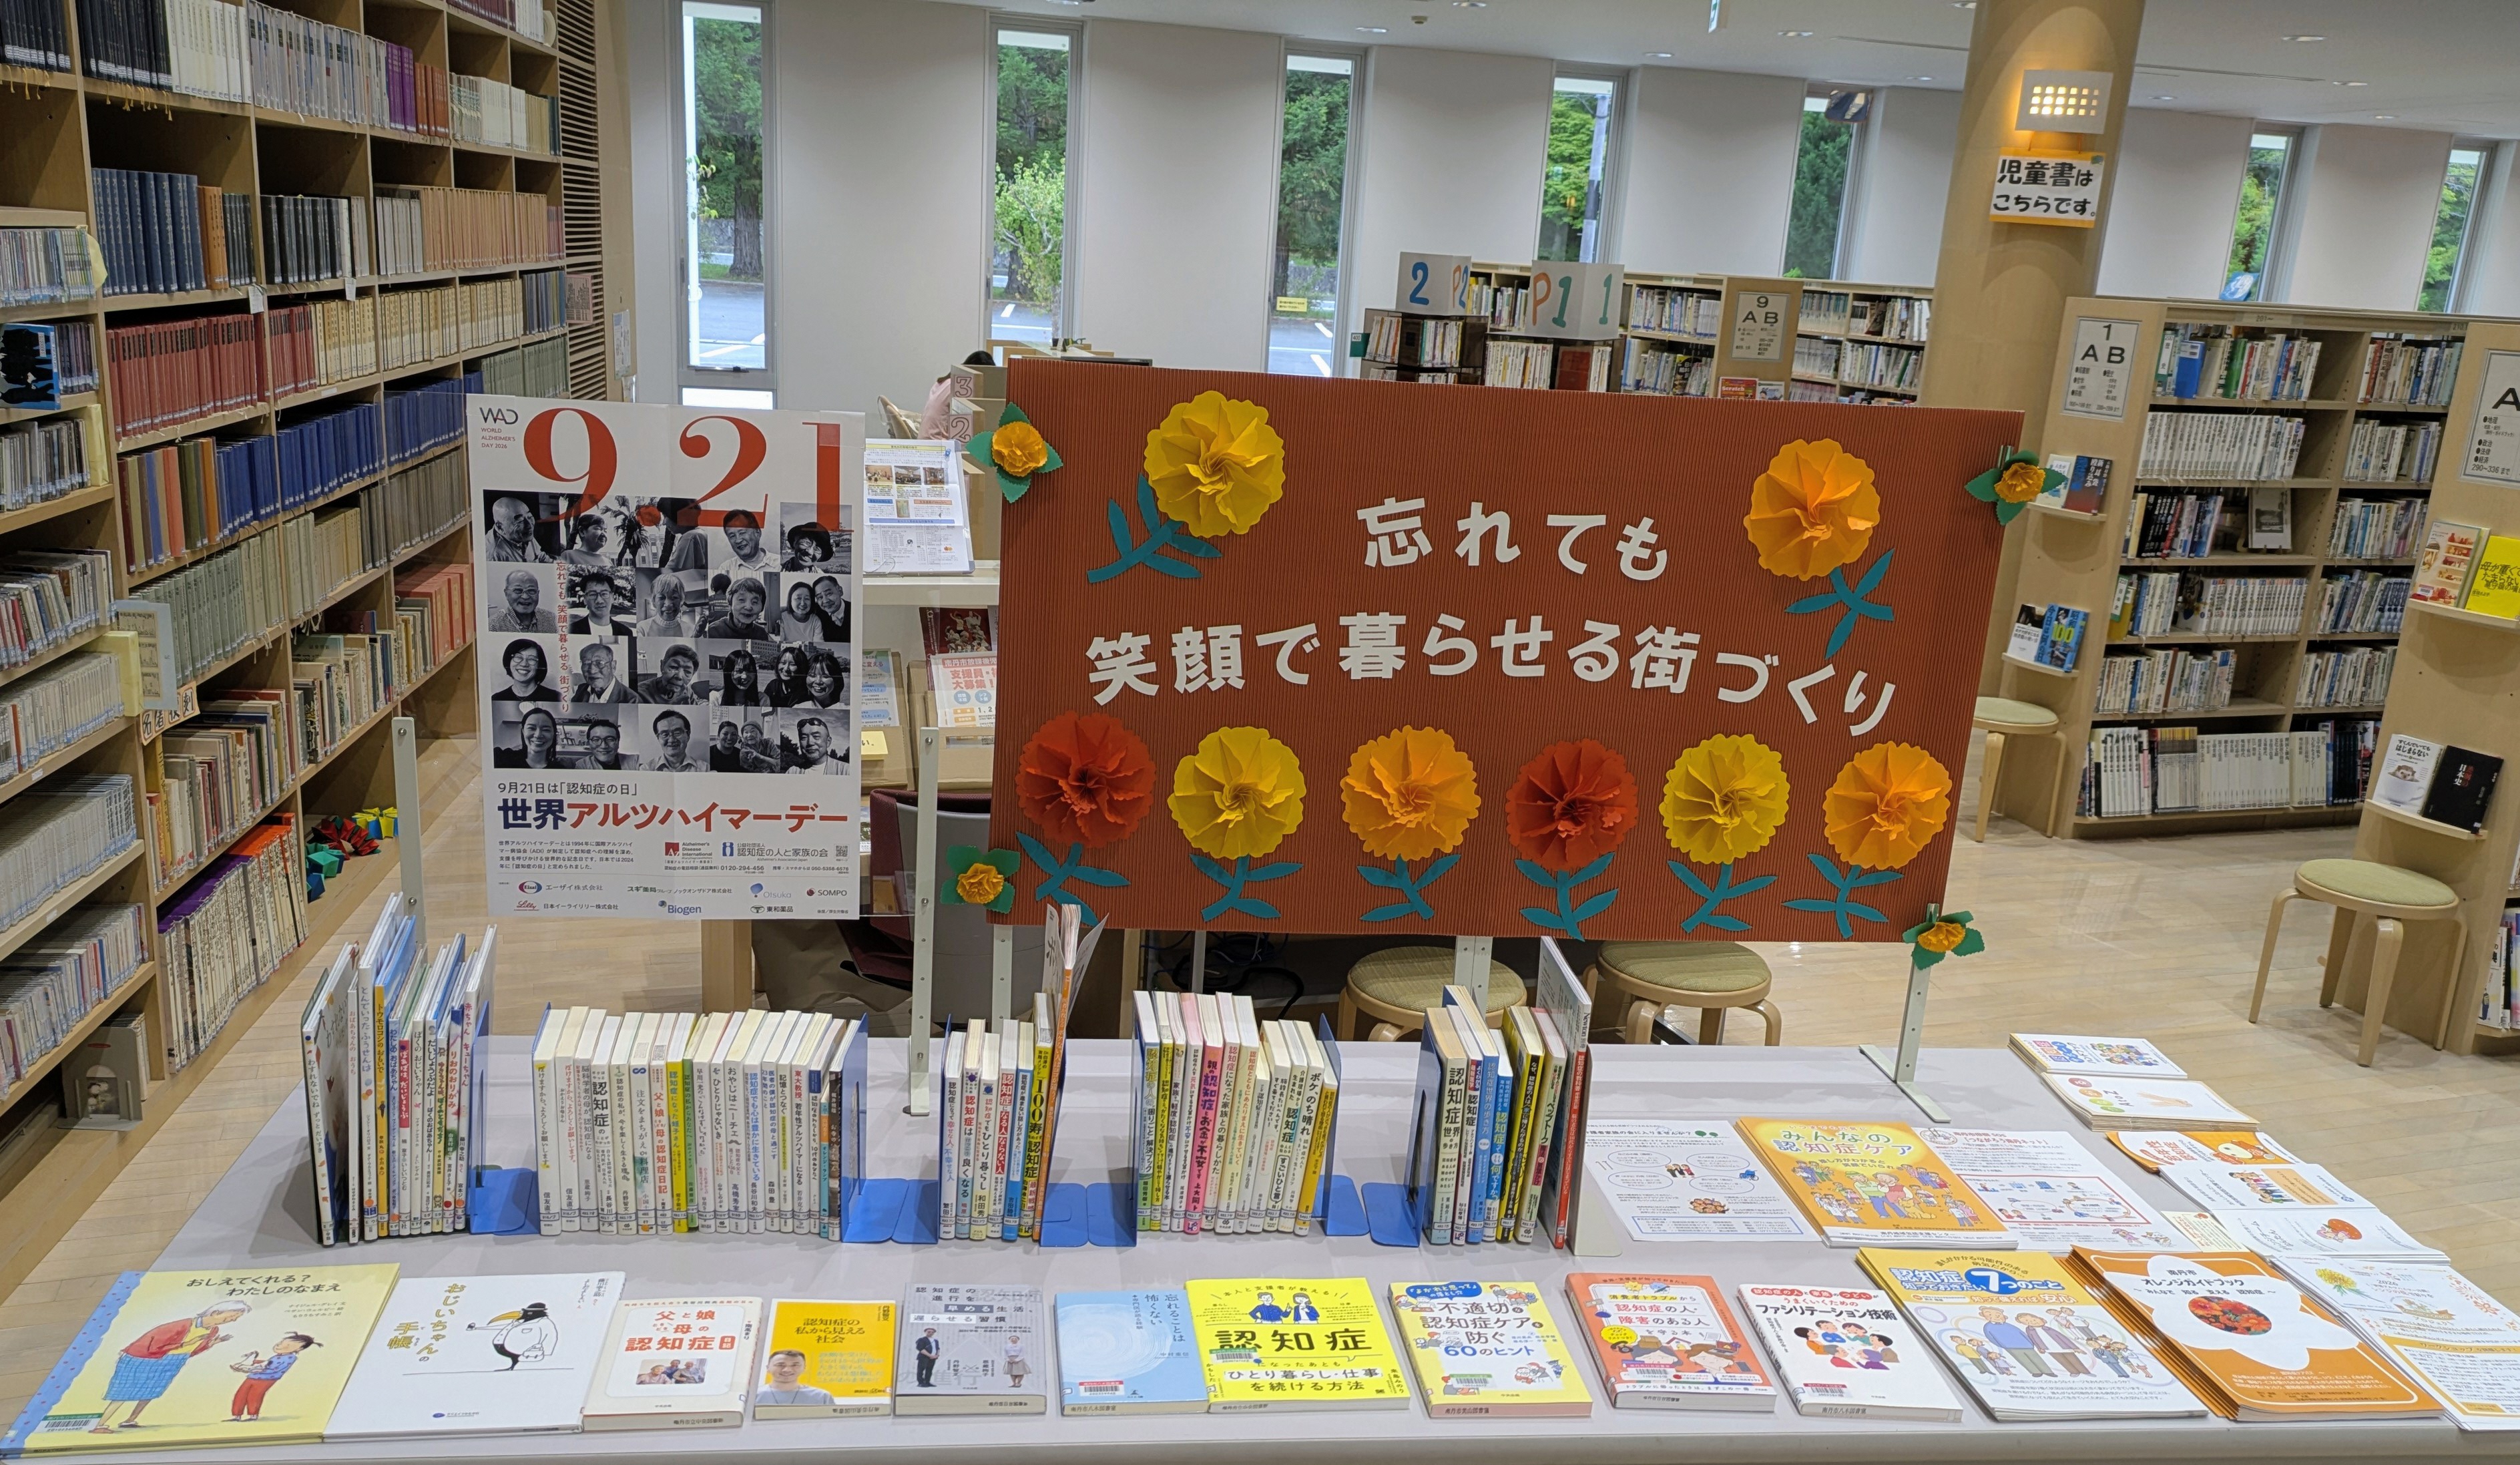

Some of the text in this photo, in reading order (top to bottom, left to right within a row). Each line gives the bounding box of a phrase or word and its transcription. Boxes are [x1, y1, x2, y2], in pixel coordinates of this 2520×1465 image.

[1997, 159, 2093, 187] 児童書は
[1993, 194, 2095, 217] こちらです。
[1409, 262, 1430, 306] 2
[1453, 264, 1469, 309] P2
[1532, 272, 1572, 329] P1
[1599, 273, 1613, 325] 1
[1756, 296, 1769, 308] 9
[1742, 310, 1778, 324] A B
[2102, 323, 2112, 341] 1
[2080, 344, 2125, 365] A B
[2491, 387, 2520, 411] A
[951, 417, 971, 443] 2
[523, 407, 854, 533] 9.21
[1356, 497, 1671, 582] 忘れても
[555, 561, 571, 714] 忘れても 笑顔で暮らせる 街づくり
[1085, 611, 1897, 737] 笑顔で暮らせる街づくり
[497, 782, 638, 796] 9月21日は「認知症の日」
[2453, 763, 2467, 787] 日本史
[497, 798, 848, 833] 世界アルツハイマーデー
[737, 847, 828, 857] 認知症の人と家族の会
[668, 904, 702, 915] Biogen
[763, 891, 792, 899] Otsuka
[818, 889, 848, 897] SOMPO
[348, 1010, 356, 1052] おばあちゃんの
[360, 987, 371, 1072] とんでいった ふうせんは
[375, 1004, 385, 1073] トウモロコシの おもいで
[461, 1002, 473, 1086] 赤ちゃん キューちゃん
[389, 1028, 398, 1091] わたしの おばあちゃん
[413, 1031, 423, 1096] ぼくの おじいちゃん
[427, 1039, 437, 1097] だいじょうぶだよ
[447, 1052, 458, 1108] りおのおりがみ
[779, 1074, 787, 1116] 記憶とつなぐ
[1445, 1067, 1465, 1124] 認知症
[1481, 1062, 1497, 1134] 認知症世界の歩き方
[307, 1059, 323, 1154] わすれないでね ずっと だいすき
[537, 1066, 551, 1169] ぼけますから、よろしくお願いします。
[565, 1064, 576, 1163] ぼけますから、よろしくお願いします。
[581, 1065, 592, 1160] 脳科学者の母が、認知症になる
[591, 1081, 610, 1134] 認知症の
[713, 1078, 722, 1139] ひとりじゃないき
[728, 1067, 738, 1137] おやじはニーチェ
[768, 1070, 778, 1160] 医者の僕が認知症の母と過ごす
[964, 1095, 977, 1136] 認知症は
[1212, 1046, 1238, 1175] 認知症になった家族との暮らしかた
[1235, 1050, 1257, 1166] 認知症とともにあたりまえに生きていく
[1300, 1072, 1322, 1136] ボケ、のち晴れ
[1465, 1094, 1478, 1126] 認知症
[615, 1078, 630, 1181] 認知症の私が、今を楽しく生きる理由
[636, 1089, 650, 1184] 注文をまちがえる料理店
[749, 1072, 760, 1181] 認知症でも心は豊かに生きている
[794, 1070, 804, 1186] 東大教授、若年性アルツハイマーになる
[944, 1081, 957, 1182] 認知症になって幸せな人、不幸せな人
[995, 1072, 1015, 1175] 認知症になる人ならない人
[1281, 1107, 1298, 1143] 認知症
[1541, 1102, 1555, 1144] ペップトーク
[1782, 1130, 1892, 1143] みんなの
[656, 1128, 668, 1194] 母の認知症日記
[979, 1098, 993, 1190] 認知症でもひとり暮らし
[1025, 1140, 1041, 1179] 認知症
[1772, 1139, 1913, 1156] 認知症ケア
[750, 1182, 758, 1213] 長谷川和夫
[961, 1158, 972, 1199] 良くなる
[1272, 1157, 1288, 1200] すごいひと言
[977, 1195, 987, 1217] 和田秀
[186, 1275, 312, 1288] おしえてくれる？
[226, 1283, 342, 1297] わたしのなまえ
[1888, 1267, 1965, 1282] 認知症
[1900, 1270, 2065, 1293] 知っておきたい 7つのこと
[2140, 1278, 2245, 1287] オレンジガイドブック
[654, 1310, 716, 1321] 父と娘
[1144, 1294, 1163, 1325] 怖くない
[1437, 1301, 1525, 1315] 不適切な
[1608, 1293, 1697, 1301] 消費者トラブルから
[1754, 1303, 1899, 1321] ファシリテーション技術
[1782, 1297, 1859, 1307] うまくいくための
[387, 1321, 420, 1350] 手帳
[417, 1283, 467, 1362] おじいちゃんの
[673, 1323, 710, 1334] 母の
[794, 1327, 866, 1335] 私から見える
[802, 1318, 860, 1326] 認知症の
[913, 1315, 1007, 1323] 遅らせる習慣
[1164, 1293, 1186, 1342] 忘れることは
[1419, 1316, 1544, 1329] 認知症ケアを
[1617, 1315, 1711, 1327] 障害のある人
[624, 1335, 716, 1352] 認知症
[1214, 1327, 1372, 1352] 認知症
[1444, 1345, 1535, 1357] 60のヒント
[1465, 1331, 1506, 1345] 防ぐ
[1250, 1380, 1365, 1392] を続ける方法
